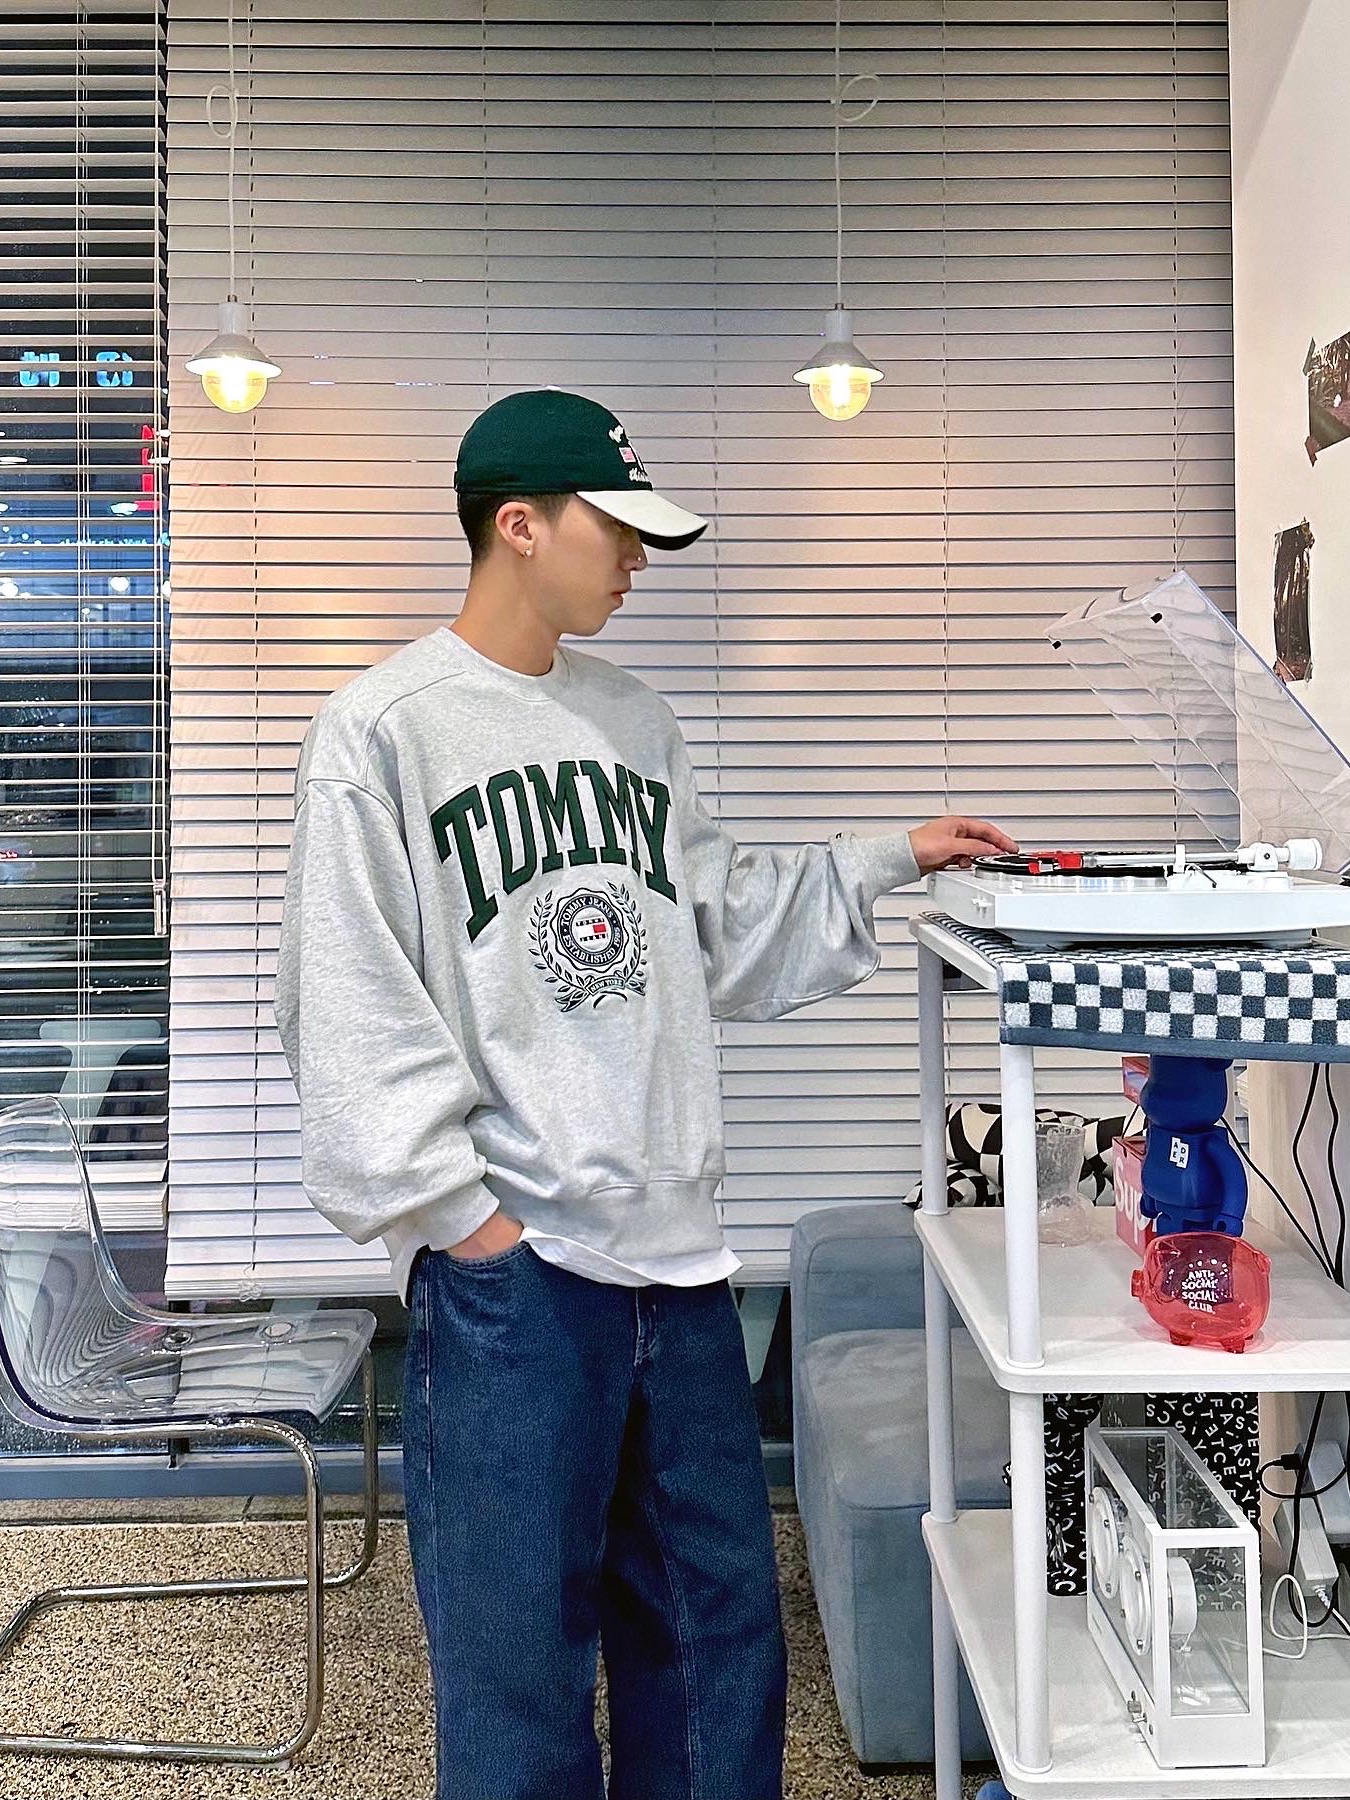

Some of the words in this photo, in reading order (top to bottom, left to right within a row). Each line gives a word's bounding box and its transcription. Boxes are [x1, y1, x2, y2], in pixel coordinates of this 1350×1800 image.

[430, 760, 678, 944] TOMMY
[560, 897, 587, 926] TOMMY
[588, 897, 614, 918] JEANS
[562, 935, 616, 964] ESTABLISHED
[590, 980, 605, 992] NEW
[1181, 1278, 1217, 1290] SOCIAL
[1181, 1290, 1218, 1303] SOCIAL
